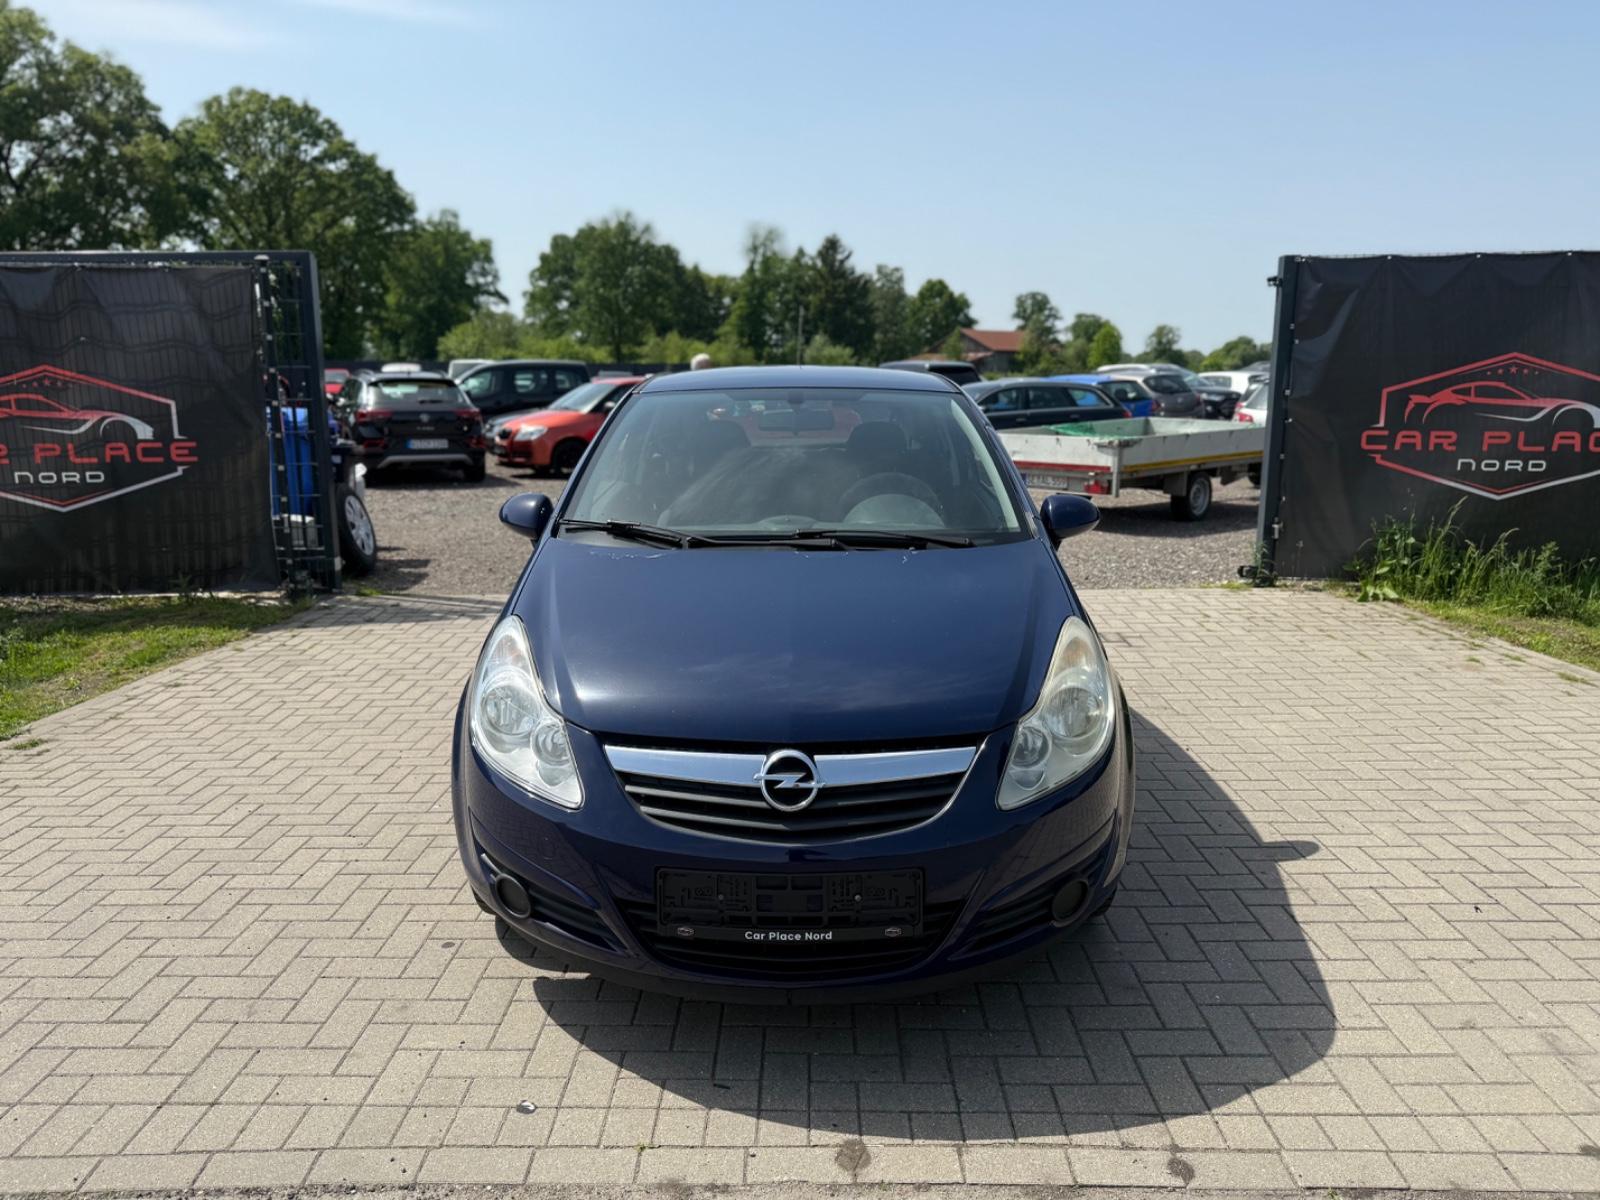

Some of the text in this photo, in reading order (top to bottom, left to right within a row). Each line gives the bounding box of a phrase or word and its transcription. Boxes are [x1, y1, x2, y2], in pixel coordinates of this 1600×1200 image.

[1360, 430, 1458, 451] CAR
[33, 441, 198, 465] PLACE
[1457, 458, 1547, 472] NORD
[14, 471, 105, 484] NORD
[744, 931, 832, 941] Car Place Nord
